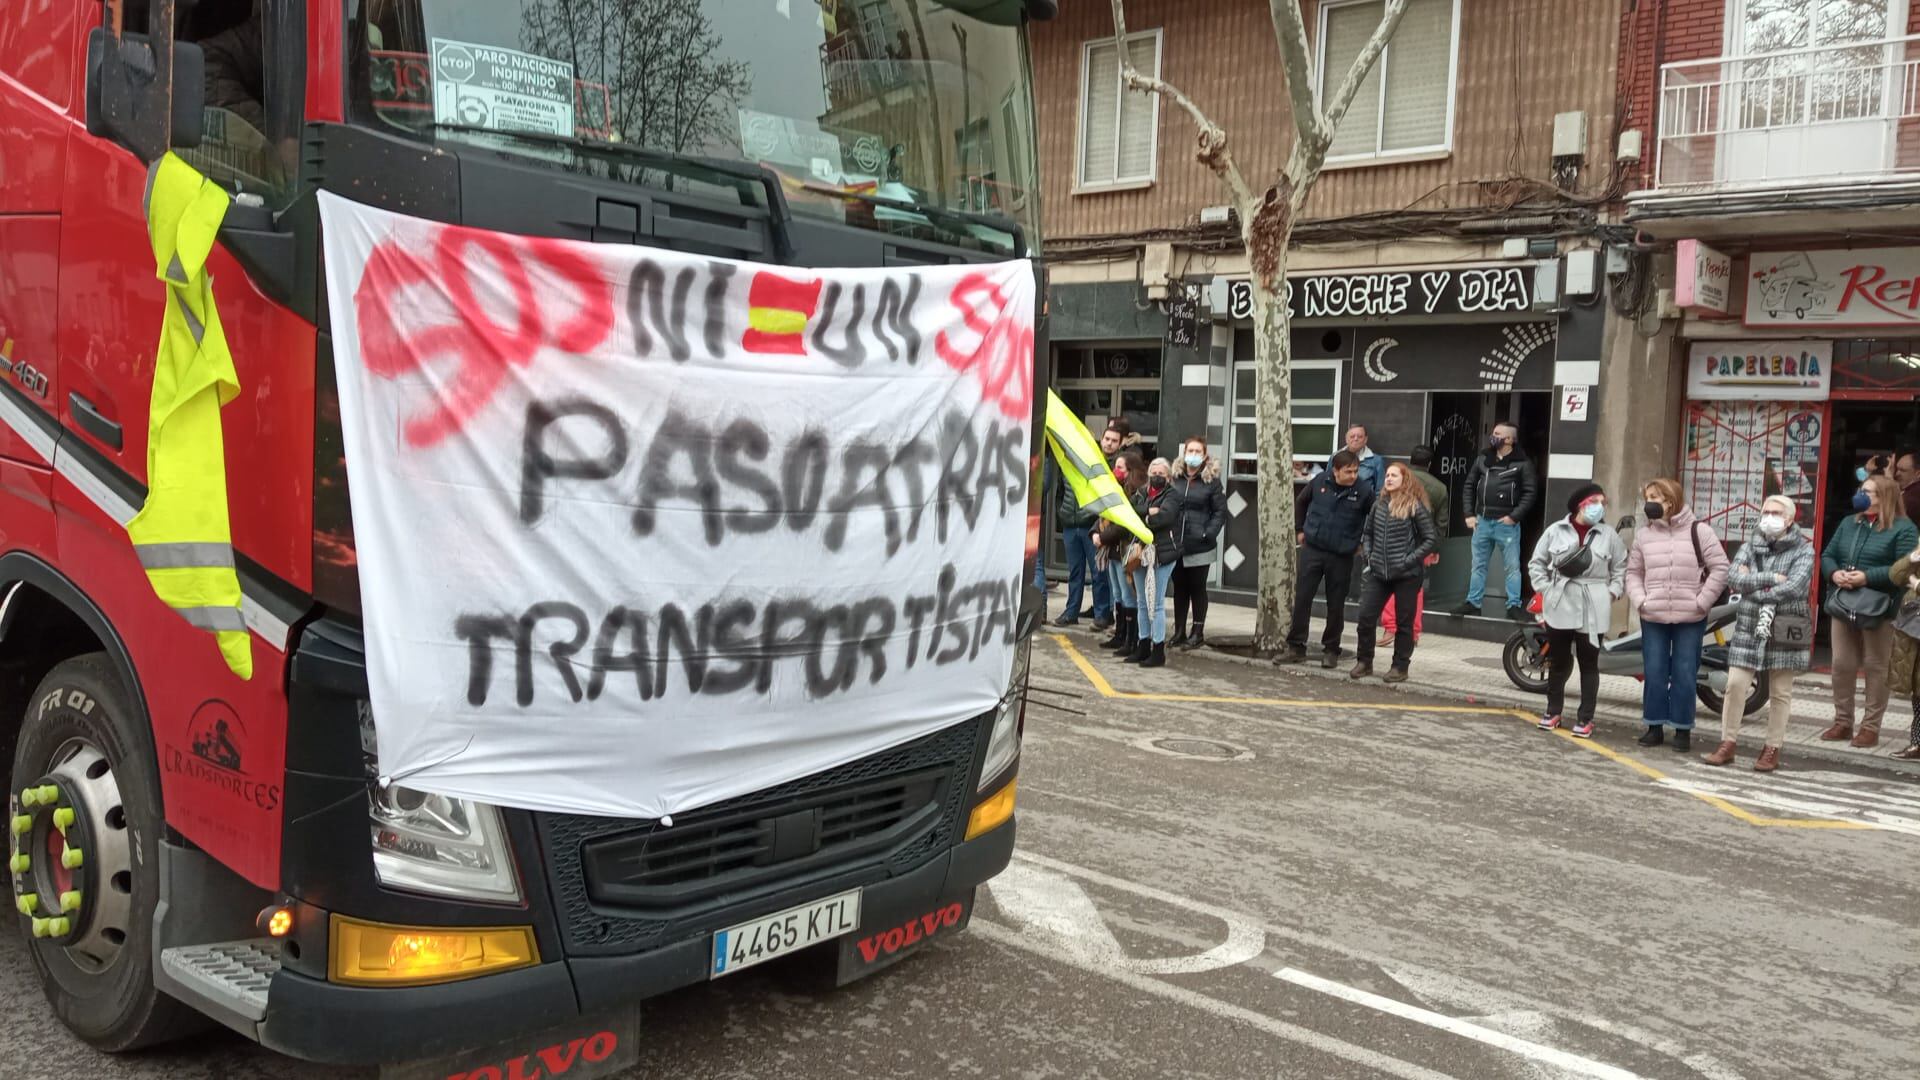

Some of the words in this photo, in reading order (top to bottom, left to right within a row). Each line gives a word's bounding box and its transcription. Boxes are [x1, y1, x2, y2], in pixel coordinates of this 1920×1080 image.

[440, 56, 472, 70] STOP
[475, 49, 508, 65] PARO
[511, 55, 570, 79] NACIONAL
[491, 65, 556, 89] INDEFINIDO
[494, 95, 556, 114] PLATAFORMA
[1304, 273, 1412, 317] NOCHE
[1420, 271, 1451, 313] Y
[1457, 268, 1529, 311] DIA
[624, 257, 737, 363] NI
[812, 271, 924, 368] UN
[13, 360, 48, 398] 460
[1706, 352, 1821, 377] PAPELERÍA
[1441, 456, 1468, 475] BAR
[731, 911, 798, 964] 4465
[806, 900, 851, 941] KTL
[856, 902, 963, 963] VOLVO
